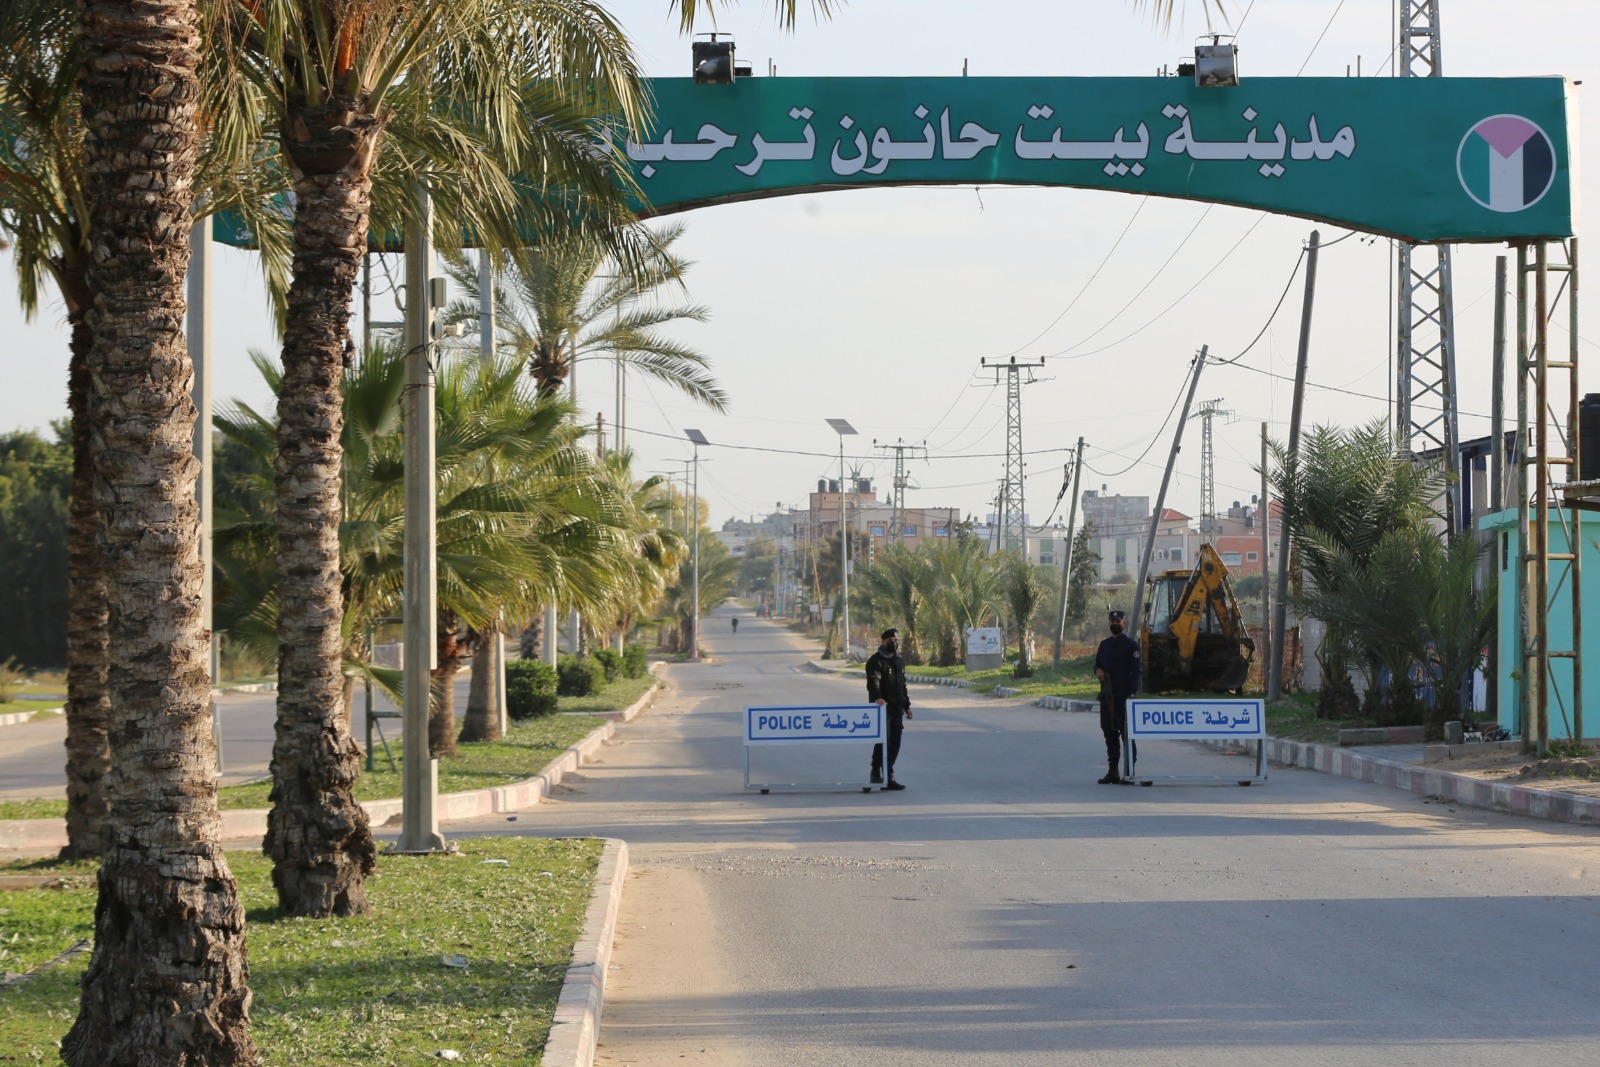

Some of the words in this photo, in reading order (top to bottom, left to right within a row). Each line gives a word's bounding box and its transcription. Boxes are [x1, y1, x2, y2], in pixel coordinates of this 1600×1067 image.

[626, 105, 816, 179] ترحب
[830, 103, 1001, 176] حانون
[1014, 104, 1150, 178] بيت
[1162, 104, 1356, 178] مدينة
[758, 715, 812, 731] POLICE
[821, 713, 871, 734] شرطة
[1142, 710, 1194, 725] POLICE
[1202, 708, 1251, 729] شرطة
